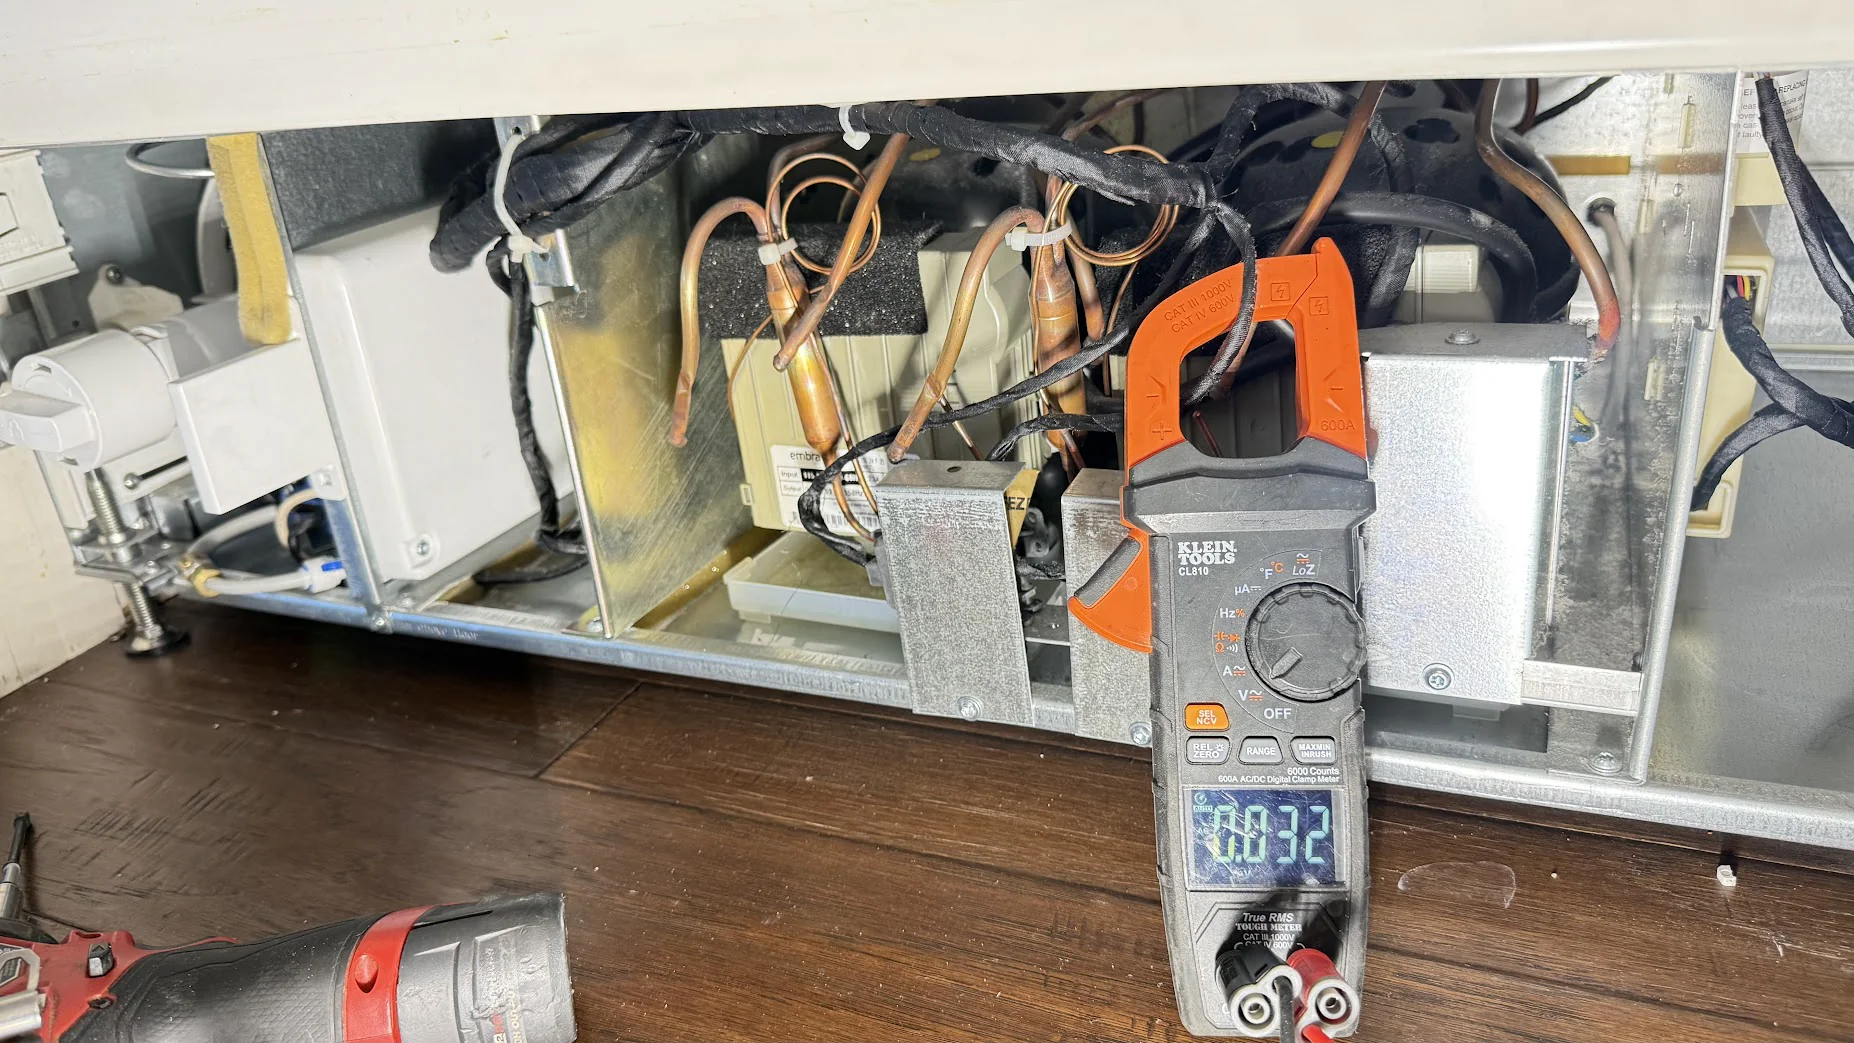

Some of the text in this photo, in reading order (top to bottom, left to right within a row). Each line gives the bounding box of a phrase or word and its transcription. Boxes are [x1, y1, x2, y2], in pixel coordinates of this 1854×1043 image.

[1164, 279, 1232, 321] CAT III 1000V
[1171, 293, 1234, 333] CAT IV 600V
[1320, 419, 1355, 431] 600A
[790, 451, 820, 462] embra
[1177, 541, 1236, 553] KLEIN
[1177, 553, 1236, 565] TOOLS
[1178, 567, 1209, 576] CL810
[1292, 564, 1315, 576] LoZ
[1198, 710, 1215, 718] SEL
[1264, 708, 1292, 719] OFF
[1196, 717, 1217, 725] NCV
[1193, 743, 1212, 751] REL
[1246, 747, 1276, 756] RANGE
[1193, 751, 1219, 759] ZERO
[1287, 767, 1340, 775] 6000 Counts
[1218, 775, 1340, 784] 600A AC/DC Digital Clamp Meter
[1212, 805, 1330, 865] 0.032
[1242, 912, 1294, 922] True RMS
[1236, 922, 1302, 931] TOUGH METER
[1243, 933, 1260, 941] CAT
[1270, 933, 1295, 941] 1000V
[1272, 941, 1293, 949] 600V
